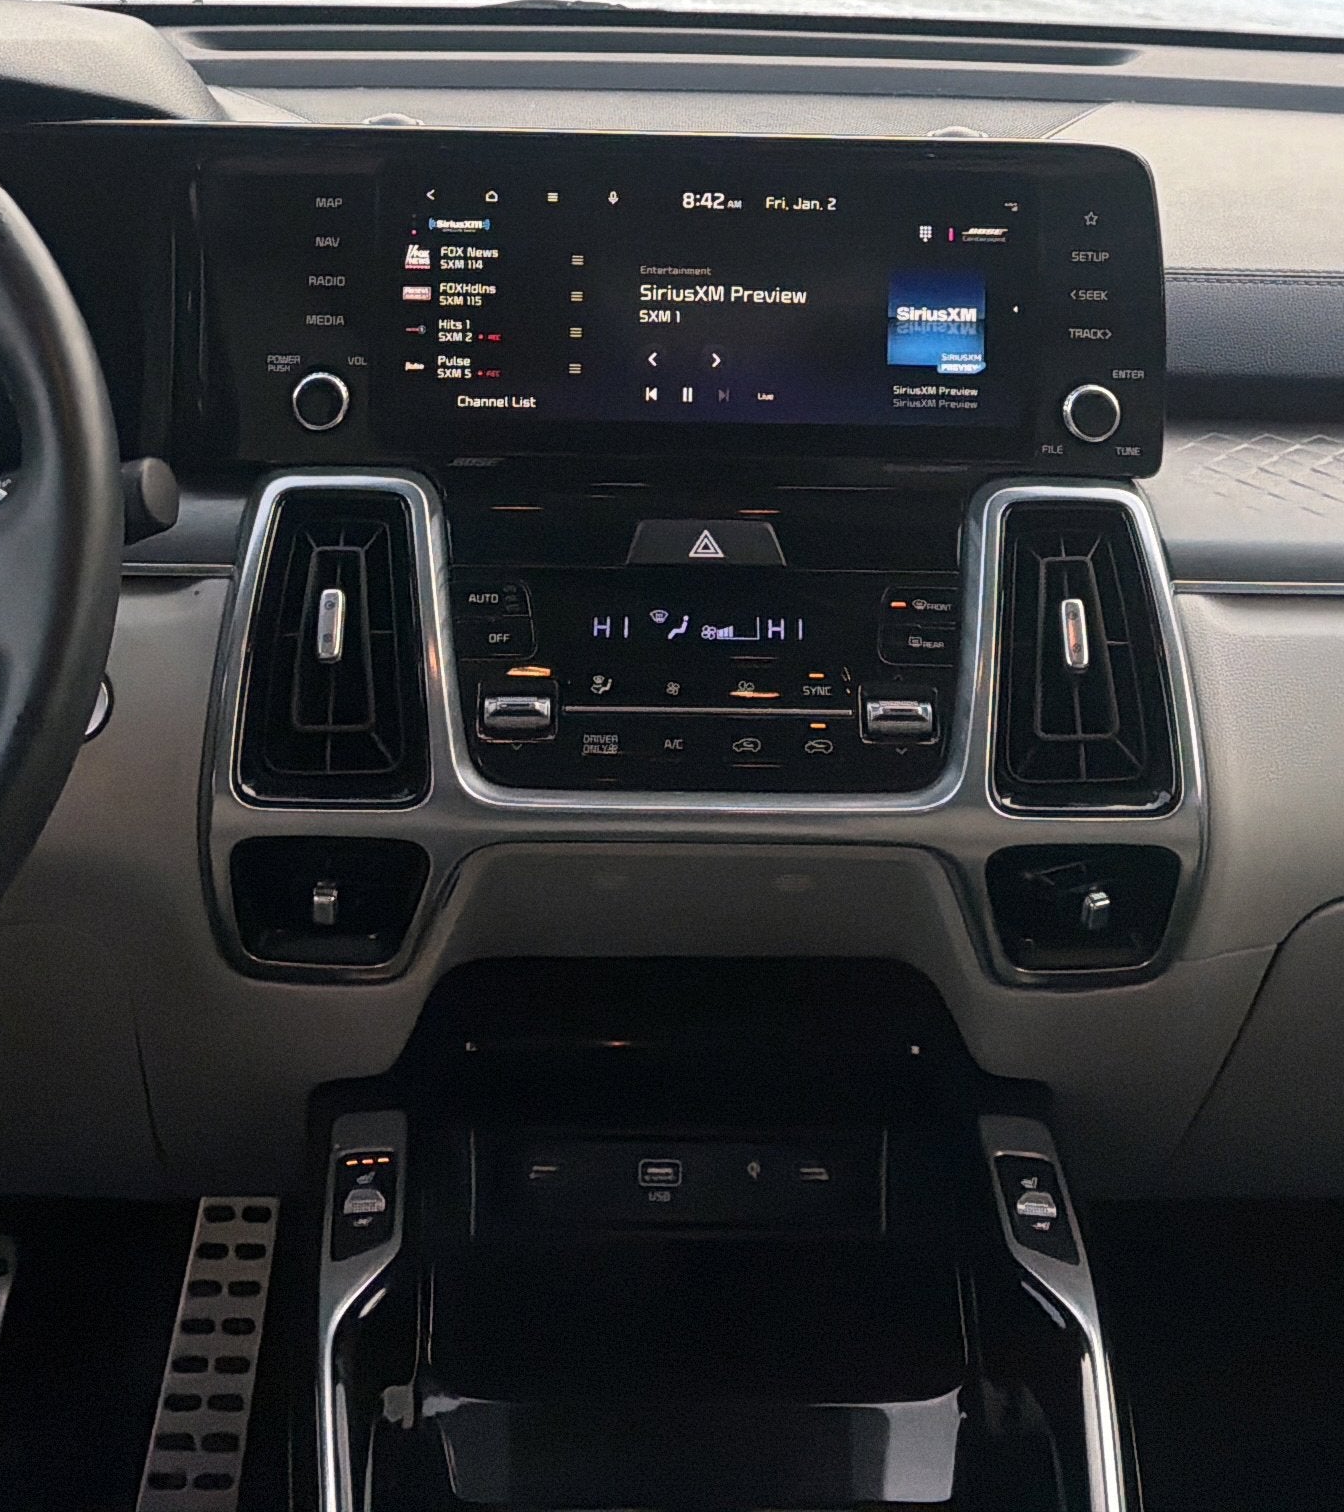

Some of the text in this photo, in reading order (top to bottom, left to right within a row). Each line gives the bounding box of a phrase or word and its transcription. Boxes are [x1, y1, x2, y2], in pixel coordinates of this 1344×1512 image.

[315, 198, 343, 207] MAP
[682, 192, 725, 210] 8:42
[727, 198, 742, 209] AM
[793, 197, 824, 211] Jan.
[827, 197, 837, 210] 2
[315, 237, 340, 247] NAV
[440, 247, 499, 258] FOX News
[1071, 251, 1109, 263] SETUP
[440, 259, 484, 269] SXM 114
[640, 265, 712, 276] Entertainment
[309, 276, 346, 286] RADIO
[640, 284, 808, 305] SiriusXM Preview
[439, 296, 482, 306] SXM 115
[639, 310, 681, 323] SXM 1
[896, 306, 977, 322] SiriusXM
[306, 316, 345, 326] MEDIA
[438, 319, 471, 329] Hits 1
[438, 332, 463, 342] SXM
[465, 332, 473, 342] 2
[267, 355, 301, 364] POWER
[347, 356, 368, 366] VOL
[437, 355, 471, 367] Pulse
[267, 364, 291, 372] PUSH
[437, 368, 462, 378] SXM
[464, 368, 472, 378] 5
[1112, 369, 1145, 380] ENTER
[893, 385, 978, 396] SiriusXM Preview
[757, 392, 774, 400] Live
[457, 395, 536, 408] Channel List
[893, 398, 978, 409] SiriusXM Preview
[1042, 445, 1063, 455] FILE
[1115, 446, 1141, 456] TUNE
[468, 593, 499, 603] AUTO
[488, 633, 511, 643] OFF
[802, 685, 832, 697] SYNC
[583, 734, 619, 744] DRIVER
[664, 738, 684, 751] A/C
[648, 1192, 671, 1202] USB
